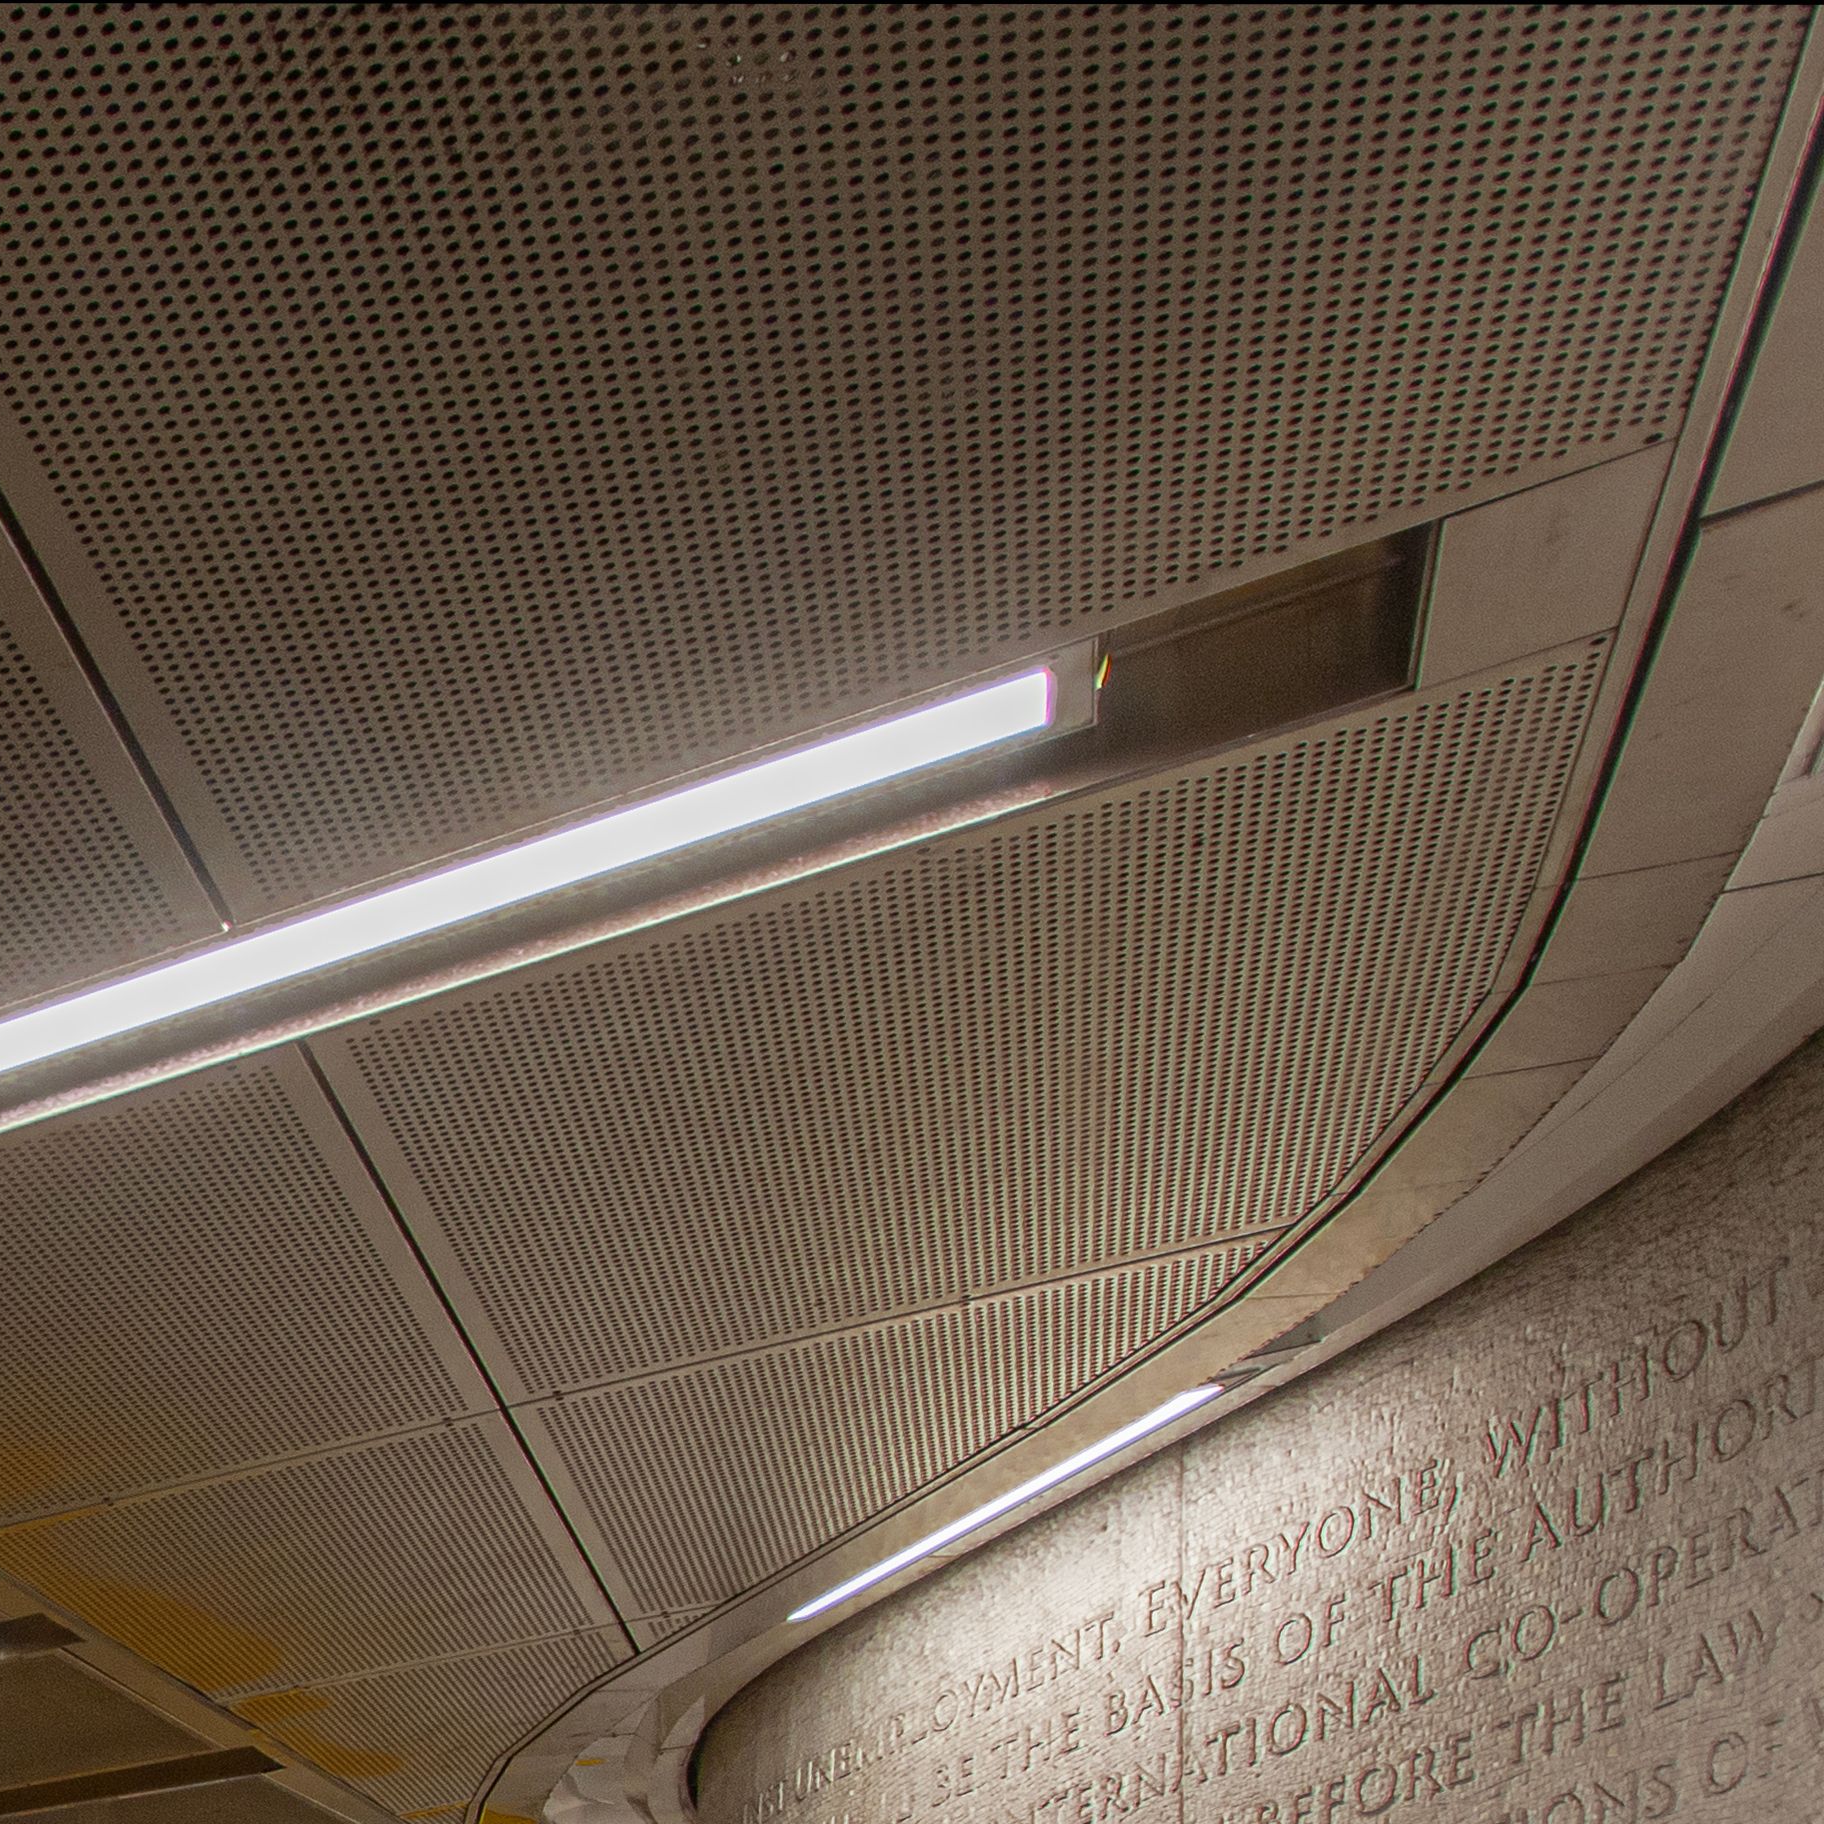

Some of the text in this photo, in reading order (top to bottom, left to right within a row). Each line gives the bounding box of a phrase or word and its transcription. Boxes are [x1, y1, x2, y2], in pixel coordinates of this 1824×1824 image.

[1138, 1458, 1460, 1637] EVERYONE,
[1486, 1256, 1790, 1478] WITHOUT
[990, 1706, 1080, 1780] THE
[1103, 1637, 1246, 1738] BASIS
[1274, 1592, 1346, 1665] OF
[1367, 1528, 1497, 1622] THE
[1463, 1470, 1824, 1680] CO-OPERAT
[1497, 1672, 1625, 1764] THE
[1653, 1606, 1782, 1711] LAW
[1704, 1720, 1783, 1795] OF
